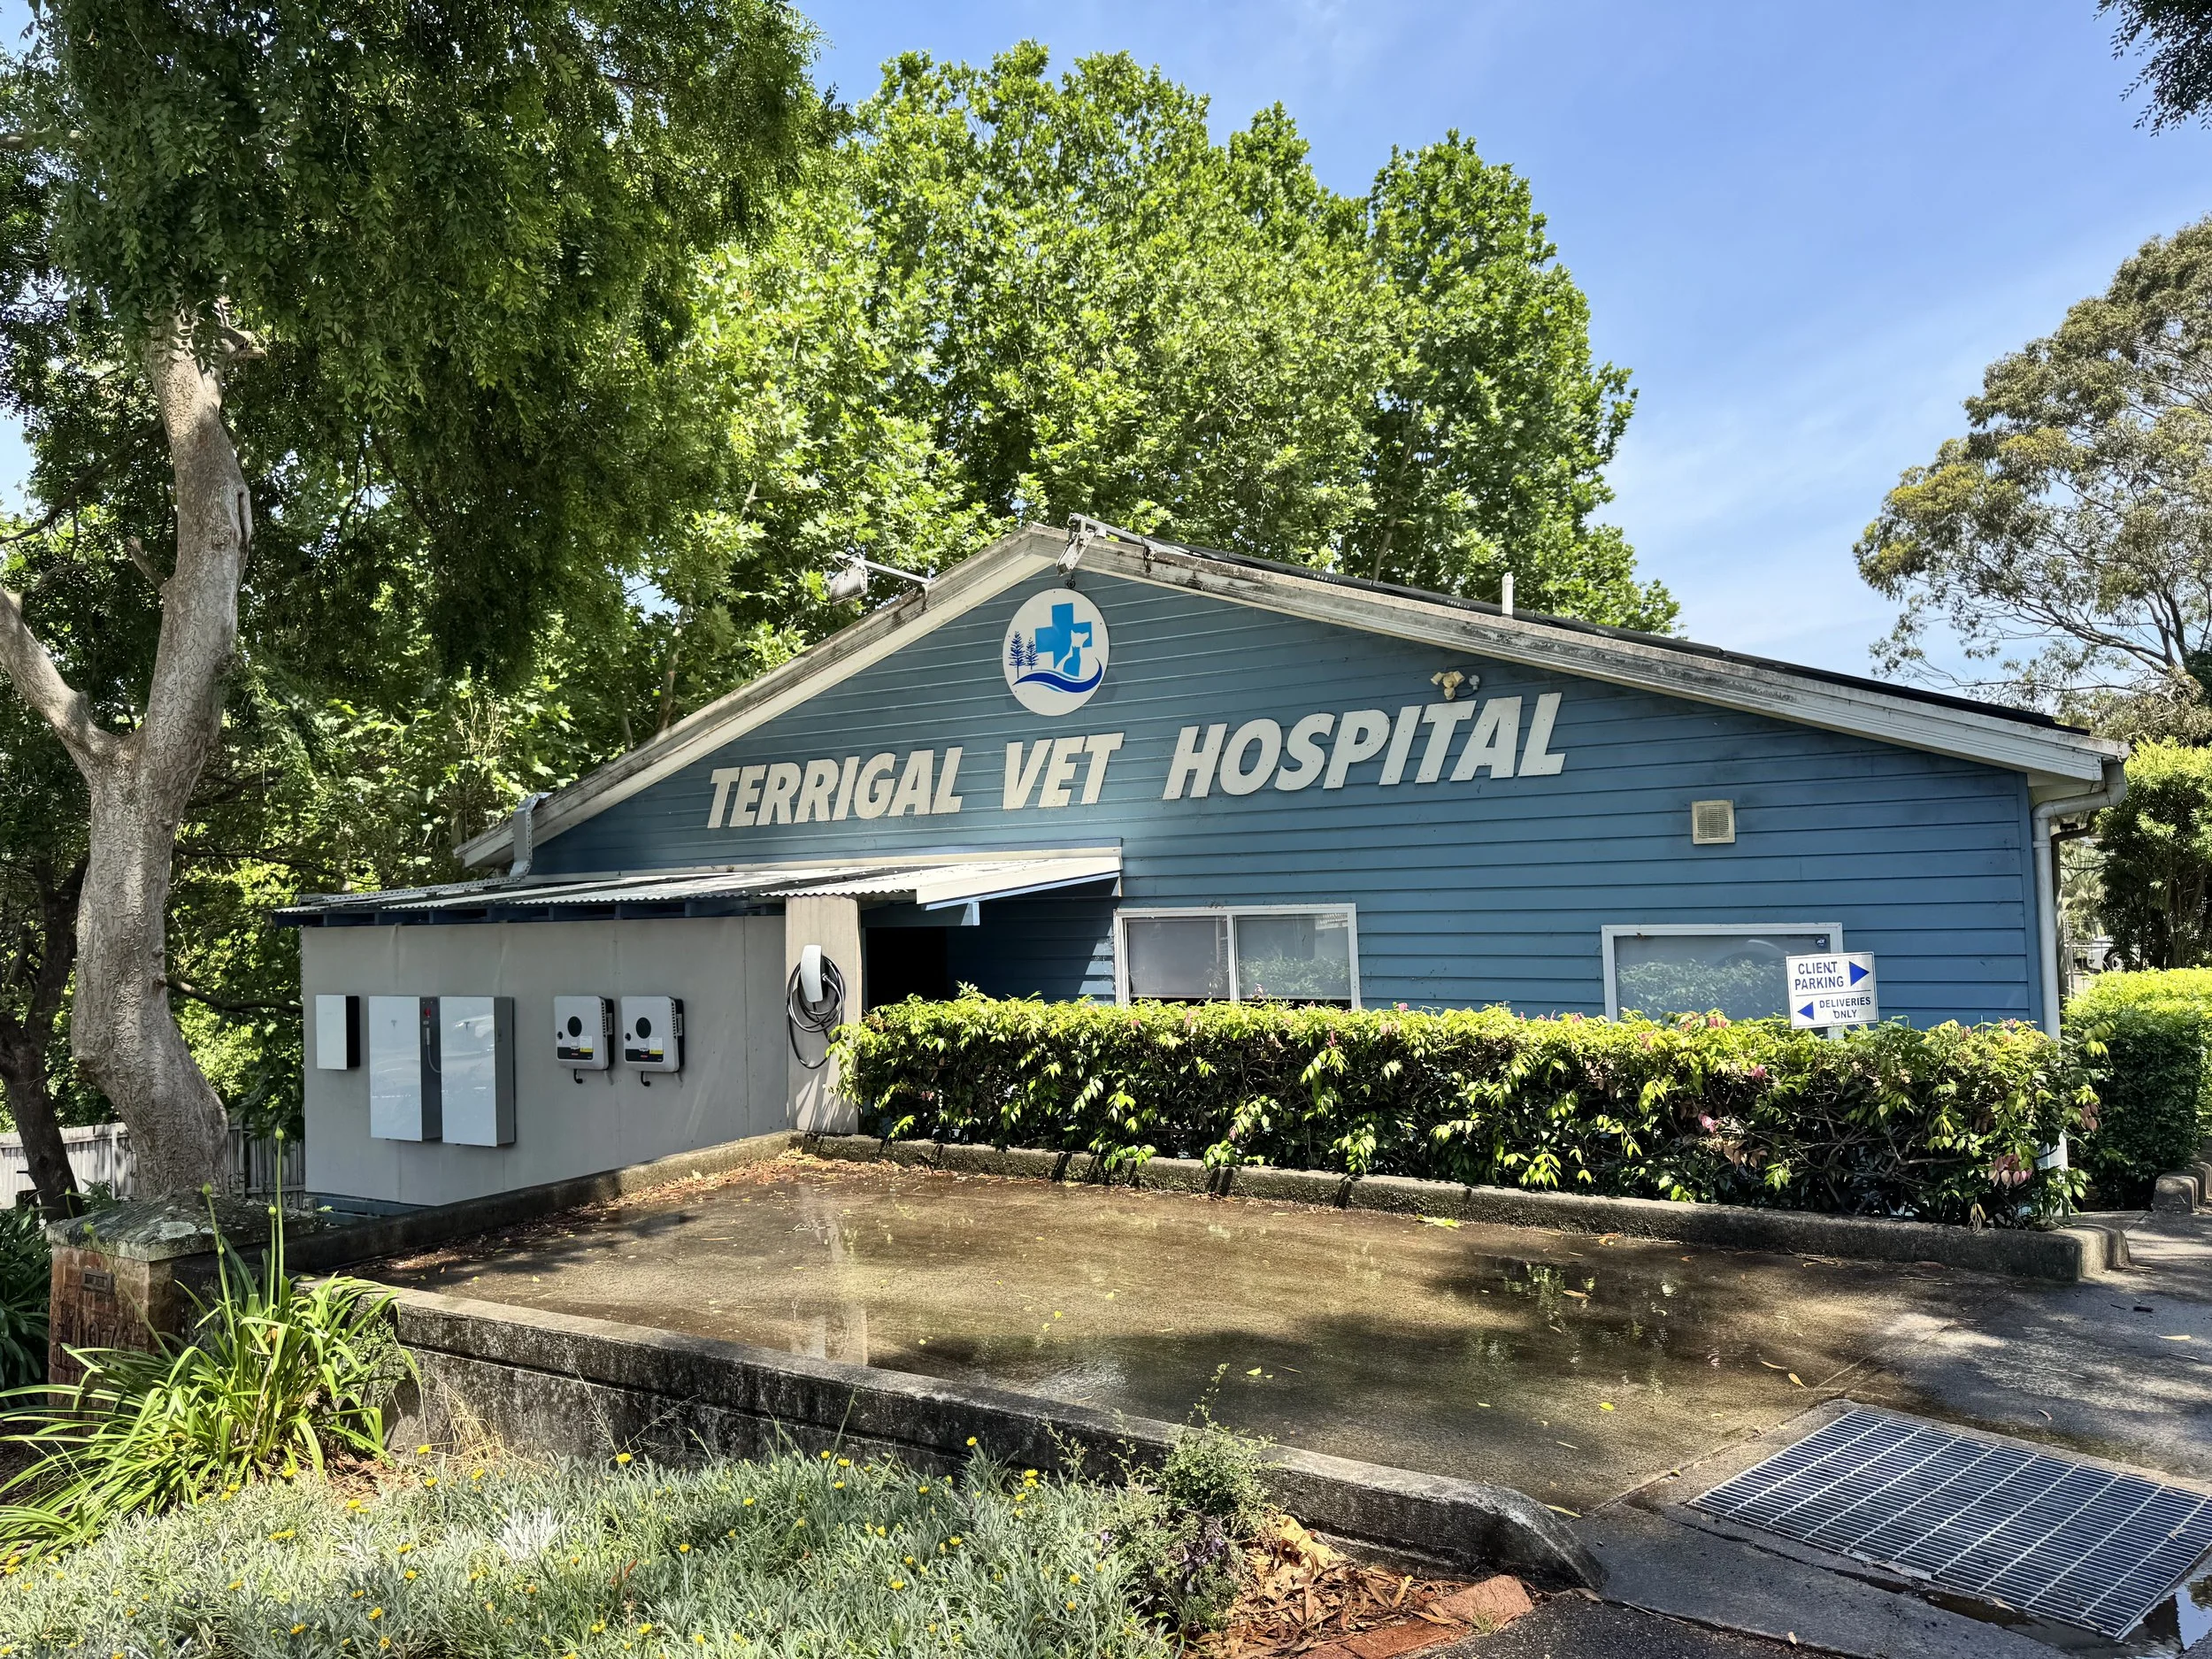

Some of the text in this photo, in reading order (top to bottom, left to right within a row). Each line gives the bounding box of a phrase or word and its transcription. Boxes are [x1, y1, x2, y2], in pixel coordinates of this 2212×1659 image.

[707, 692, 1566, 829] TERRIGAL VET HOSPITAL
[1798, 961, 1838, 975] CLIENT
[1794, 976, 1844, 990] PARKING
[1819, 996, 1871, 1009] DELIVERIES
[1833, 1009, 1857, 1018] ONLY
